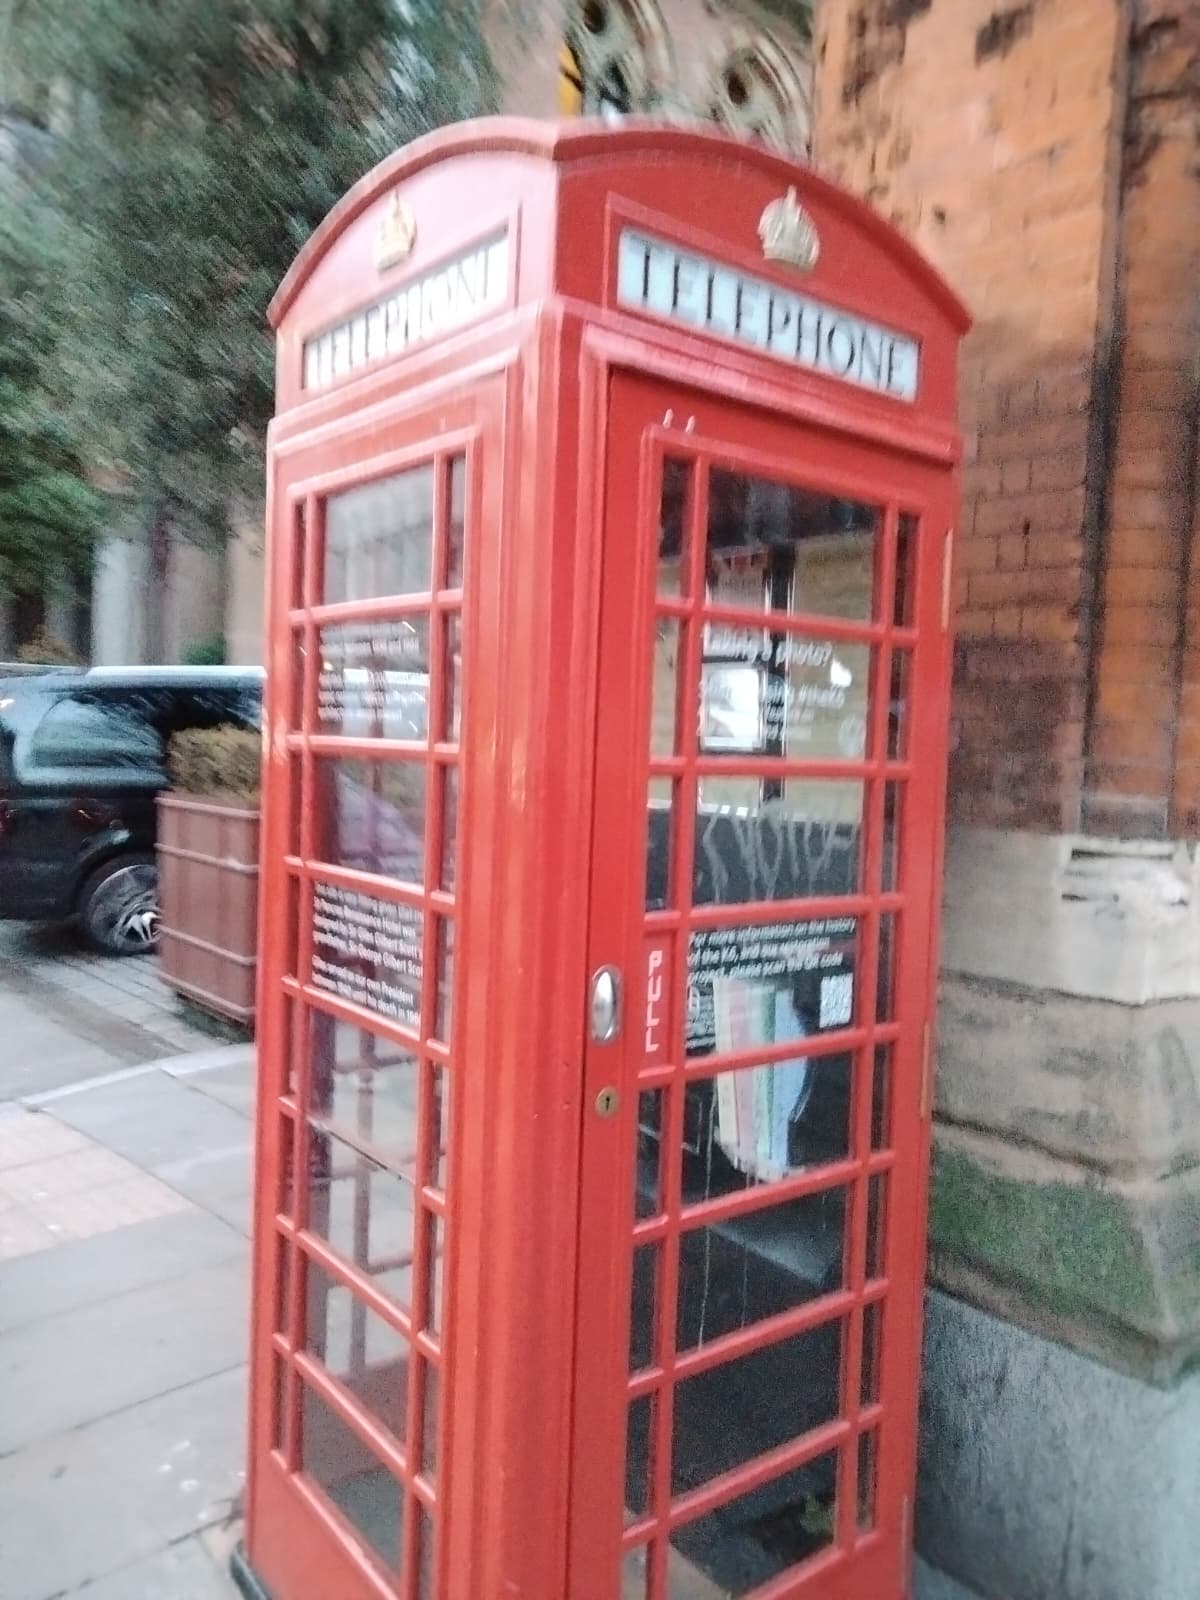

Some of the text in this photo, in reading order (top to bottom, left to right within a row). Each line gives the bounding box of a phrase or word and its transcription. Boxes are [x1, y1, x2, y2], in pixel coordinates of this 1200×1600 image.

[624, 236, 908, 396] TELEPHONE
[709, 928, 736, 945] more
[737, 921, 794, 943] information
[795, 919, 808, 934] on
[808, 917, 824, 933] the
[825, 916, 858, 934] history
[702, 947, 720, 965] the
[721, 945, 739, 965] K6,
[739, 942, 760, 961] and
[761, 942, 778, 959] our
[730, 962, 762, 981] please
[763, 962, 786, 979] scan
[787, 957, 804, 973] the
[804, 954, 820, 971] QR
[820, 951, 844, 968] code
[645, 950, 663, 1053] PULL
